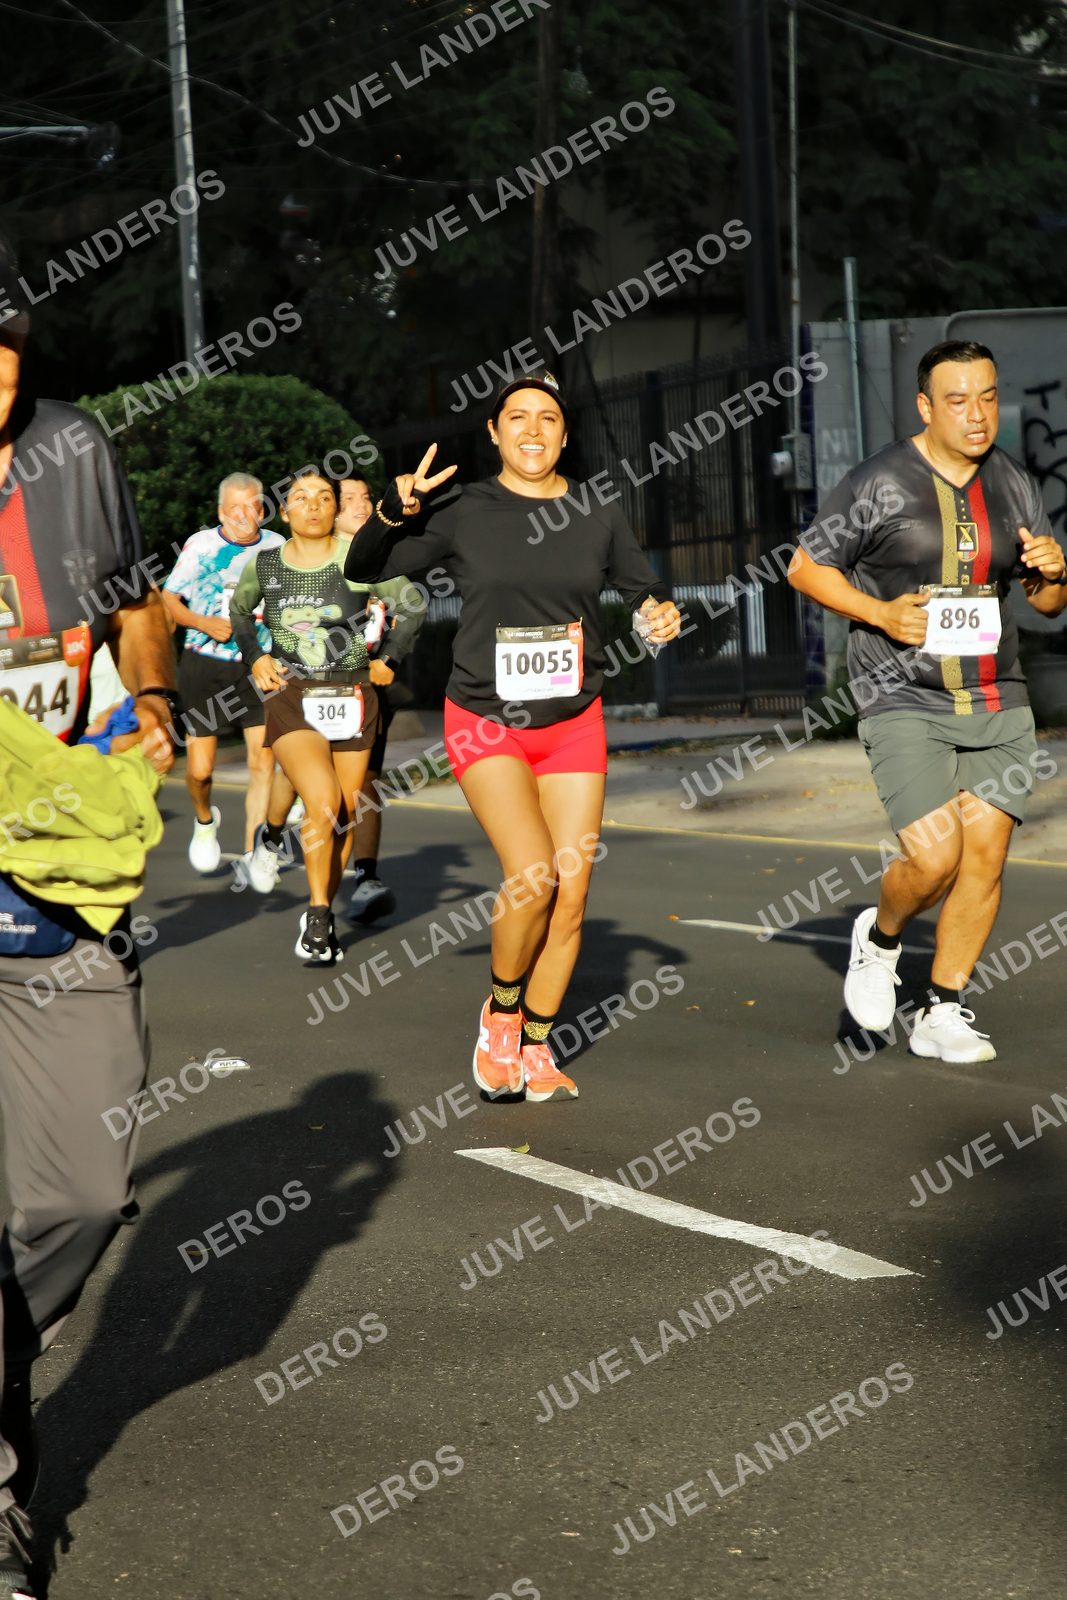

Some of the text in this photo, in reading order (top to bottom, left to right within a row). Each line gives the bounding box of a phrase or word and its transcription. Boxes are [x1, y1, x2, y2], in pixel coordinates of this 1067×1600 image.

[940, 608, 980, 629] 896
[502, 649, 573, 675] 10055
[317, 703, 347, 721] 304
